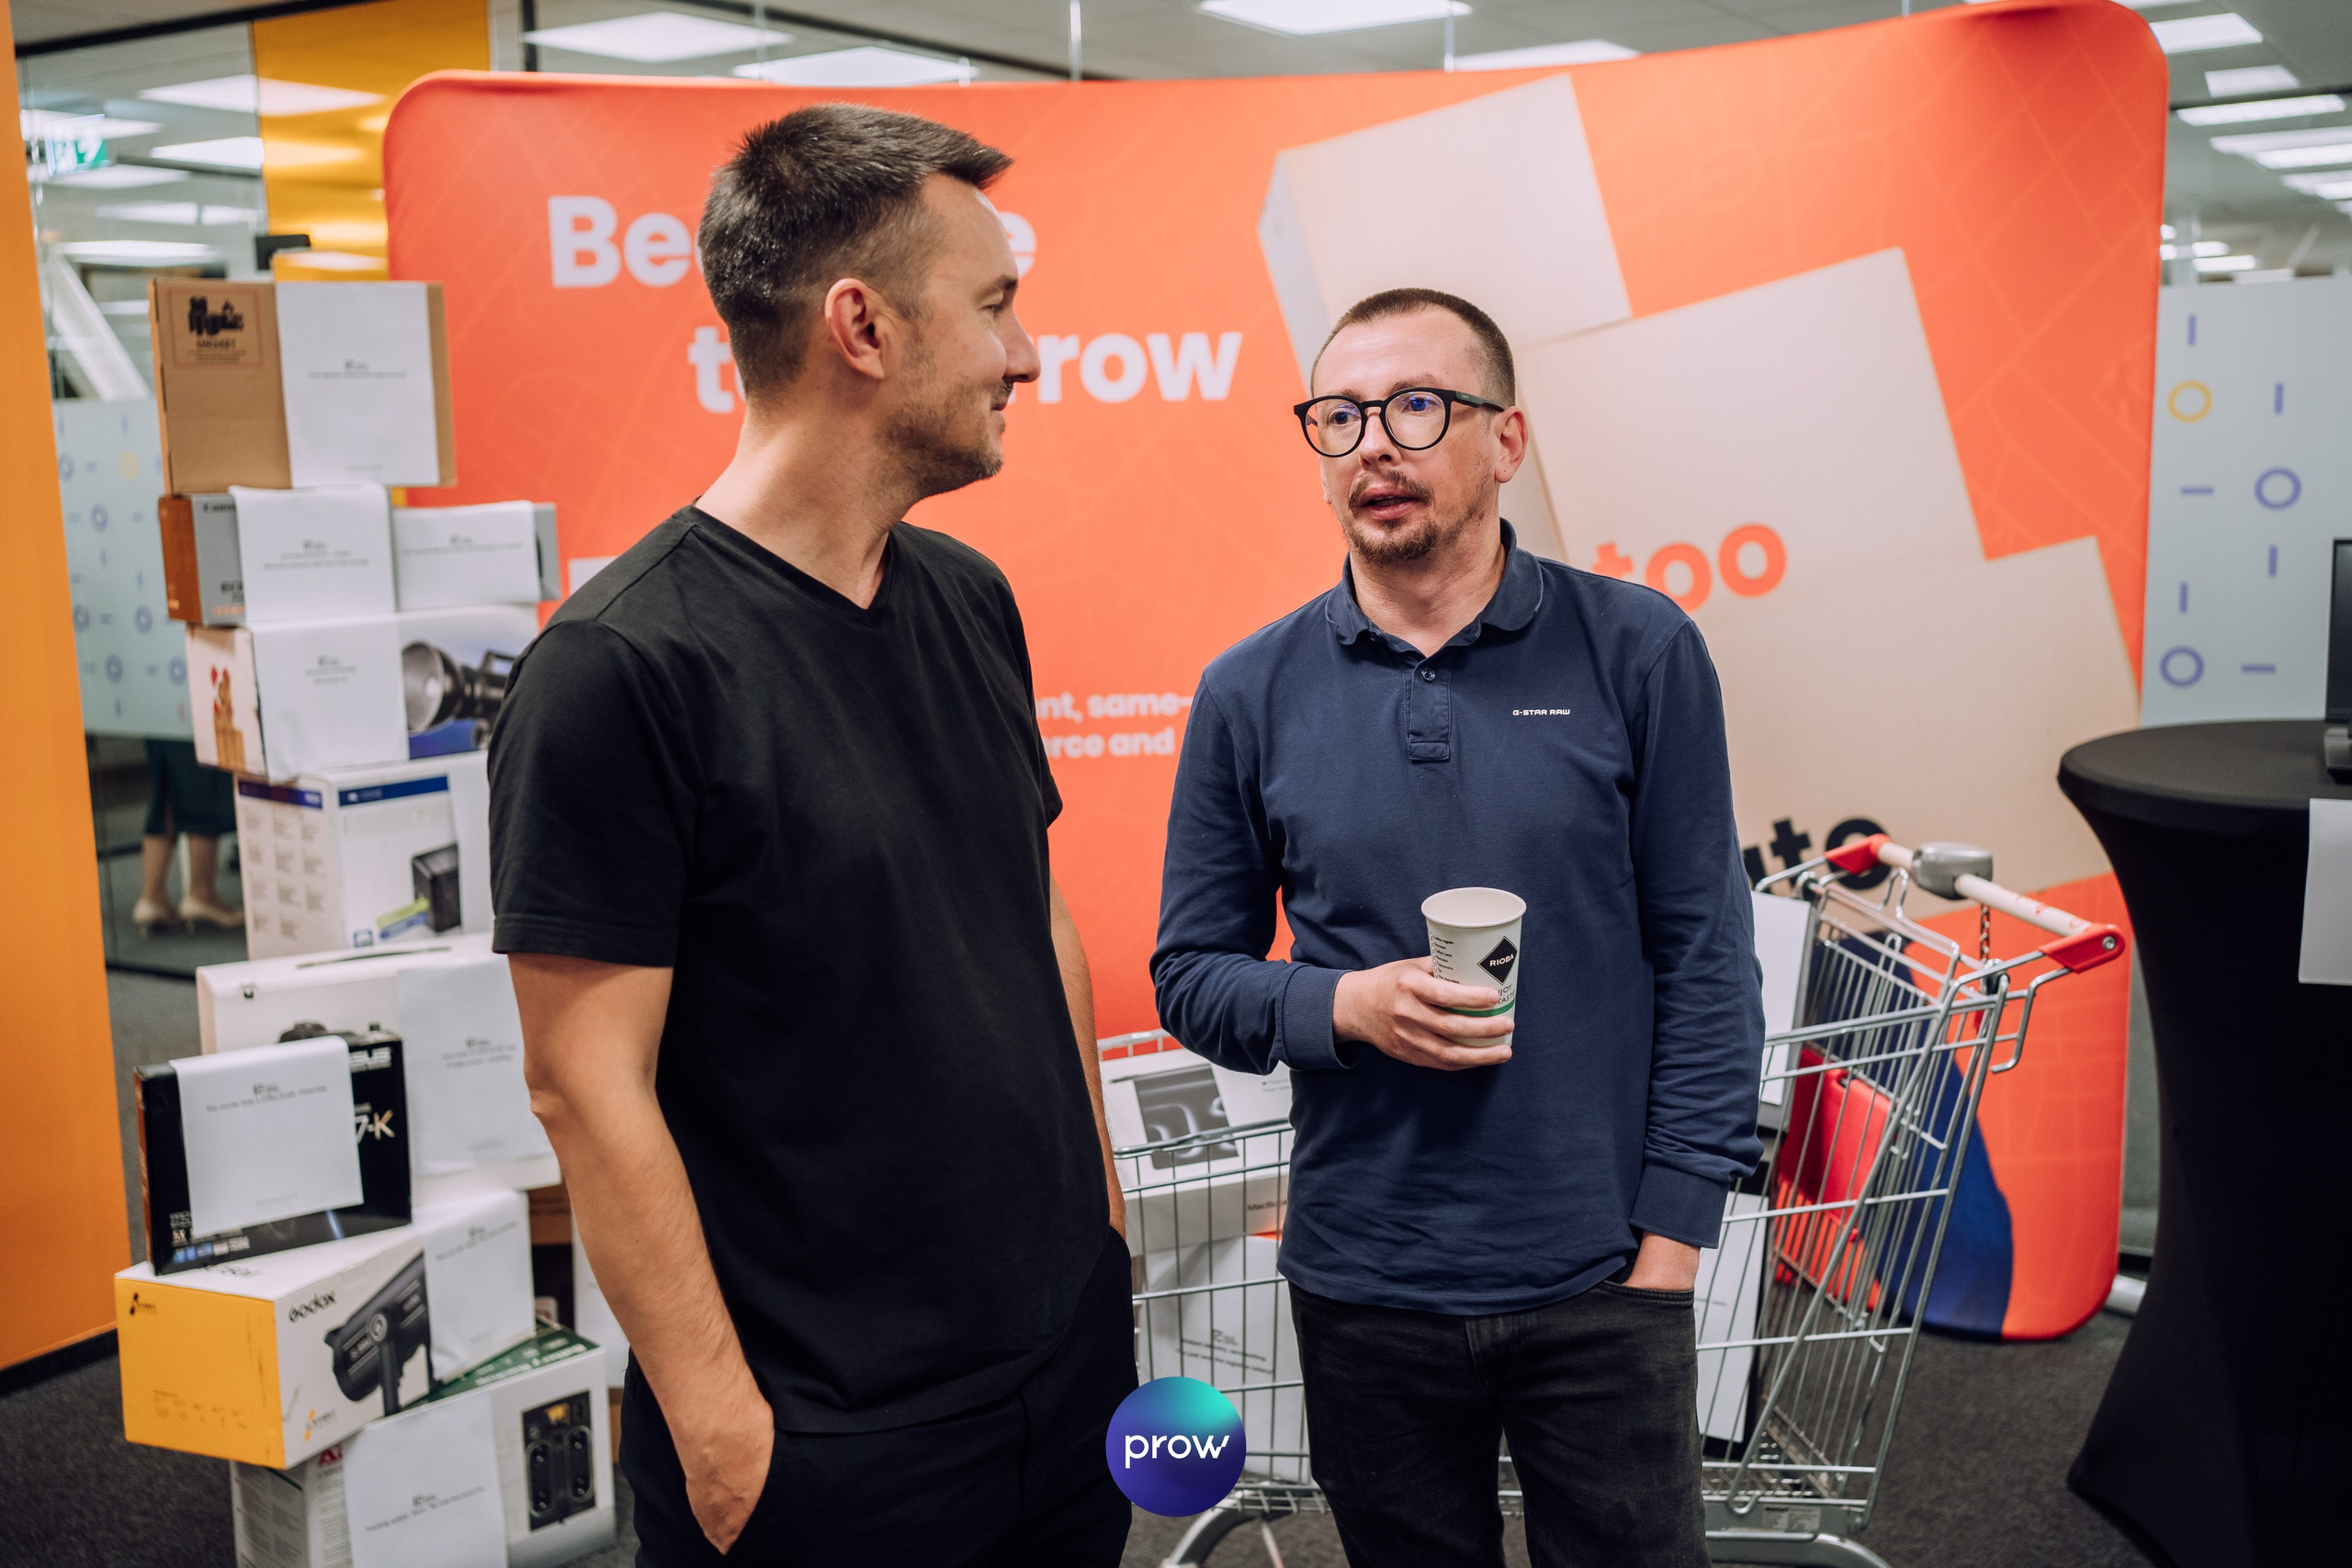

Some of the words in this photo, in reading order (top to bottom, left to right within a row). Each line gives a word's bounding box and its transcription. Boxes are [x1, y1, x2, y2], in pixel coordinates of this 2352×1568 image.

[1035, 691, 1083, 722] nt,
[1043, 732, 1104, 759] rce
[1108, 725, 1176, 758] and
[1489, 953, 1514, 966] RIOBA
[1498, 984, 1512, 997] JOY
